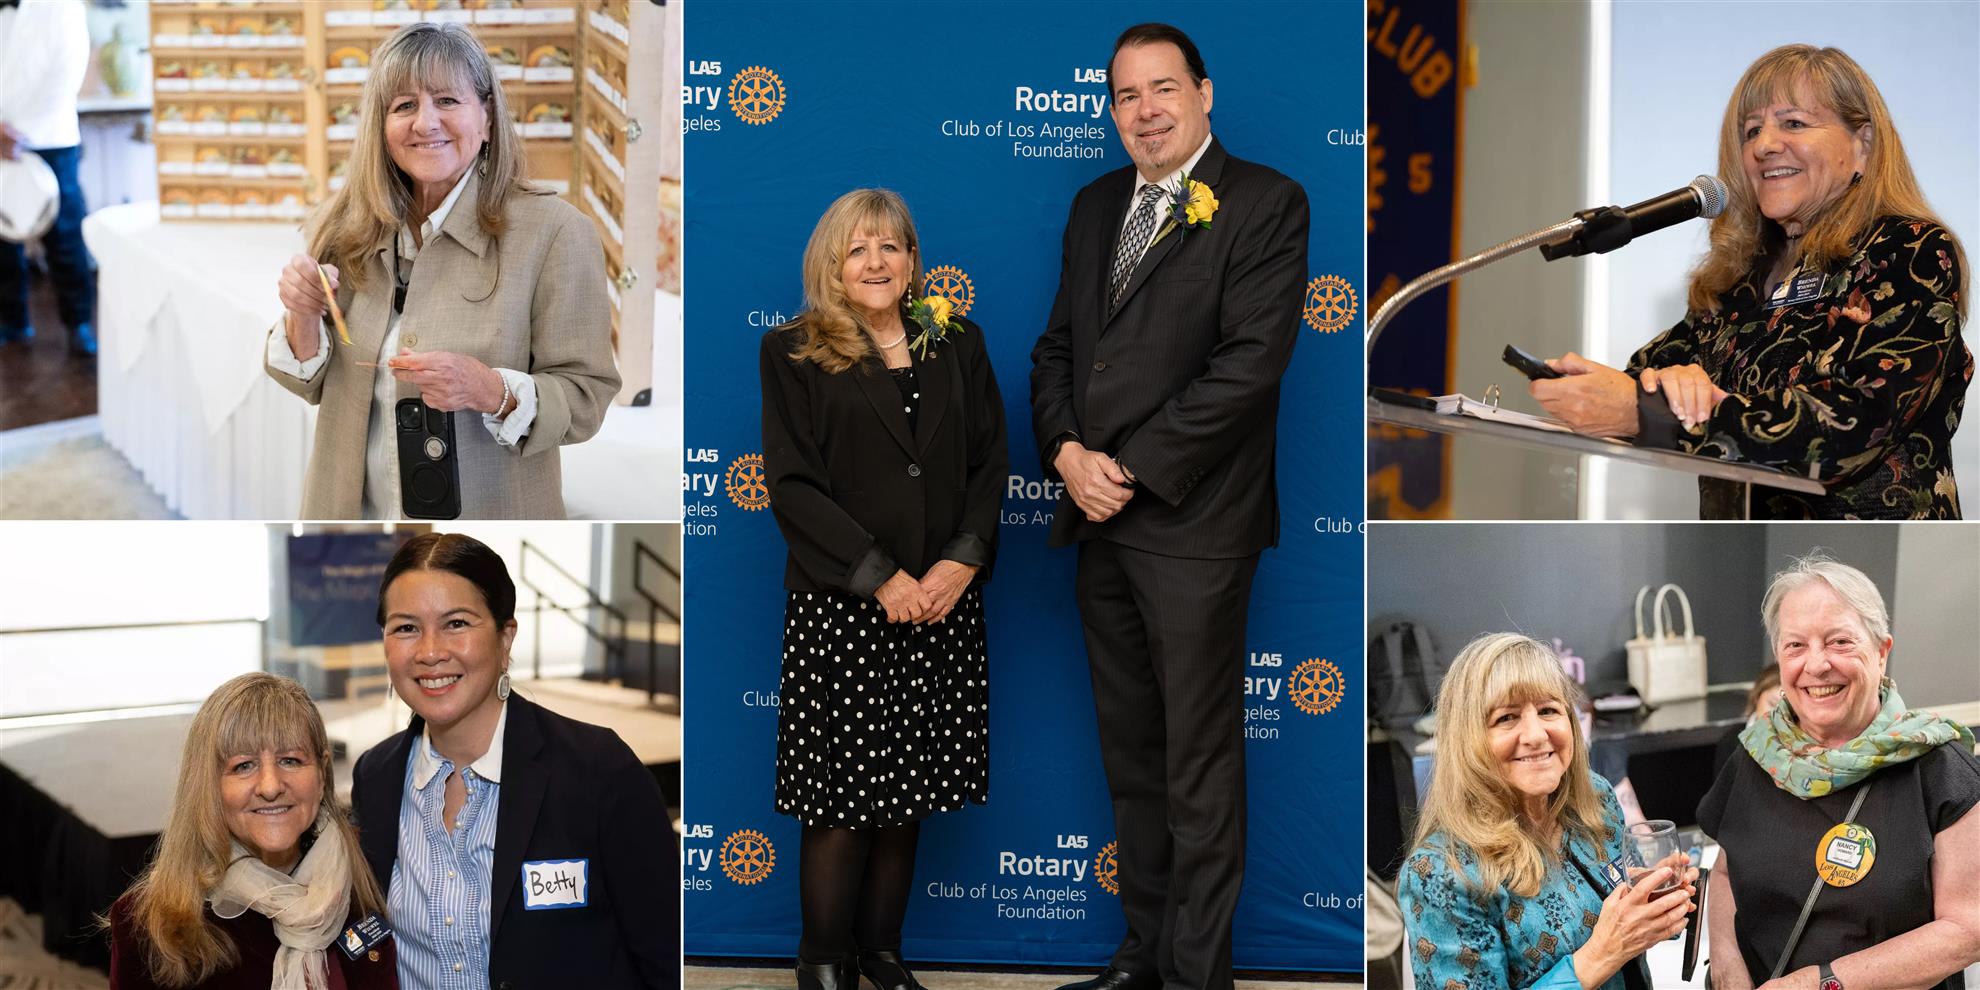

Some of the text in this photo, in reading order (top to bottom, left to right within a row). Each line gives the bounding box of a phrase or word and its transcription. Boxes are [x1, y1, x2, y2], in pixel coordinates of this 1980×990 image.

[689, 60, 722, 75] LA5
[1074, 68, 1107, 83] LA5
[1015, 86, 1107, 119] Rotary
[941, 119, 1105, 143] Club of Los Angeles
[1327, 128, 1364, 146] Club
[1014, 141, 1104, 159] Foundation
[687, 448, 719, 463] LA5
[1000, 508, 1027, 525] Los
[1314, 516, 1353, 534] Club
[1250, 652, 1283, 667] LA5
[743, 690, 780, 707] Club
[1056, 834, 1089, 849] LA5
[1836, 841, 1858, 851] NANCY
[999, 851, 1088, 882] Rotary
[530, 870, 578, 900] Betty
[927, 882, 1087, 905] Club of Los Angeles
[1303, 892, 1364, 909] Club of
[997, 903, 1086, 920] Foundation
